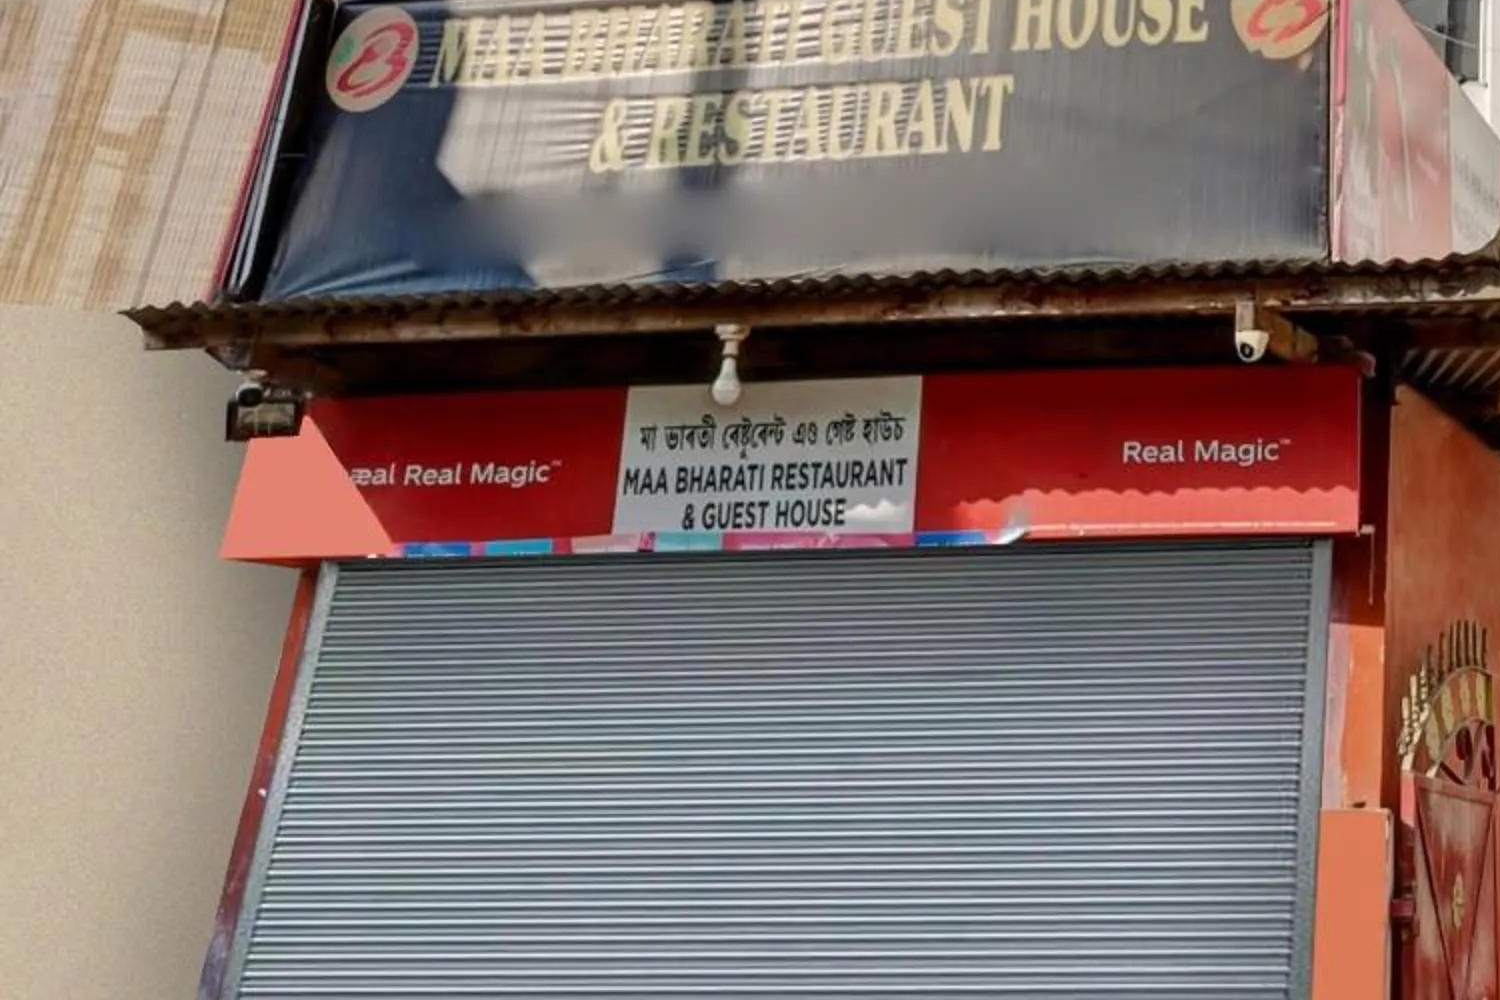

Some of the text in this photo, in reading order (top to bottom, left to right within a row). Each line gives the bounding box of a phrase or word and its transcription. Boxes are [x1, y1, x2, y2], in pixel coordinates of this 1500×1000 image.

[590, 74, 1013, 173] & RESTAURANT
[1122, 439, 1185, 464] Real
[403, 461, 463, 486] Real
[623, 458, 908, 496] MAA BHARATI RESTAURANT
[682, 498, 846, 530] & GUEST HOUSE
